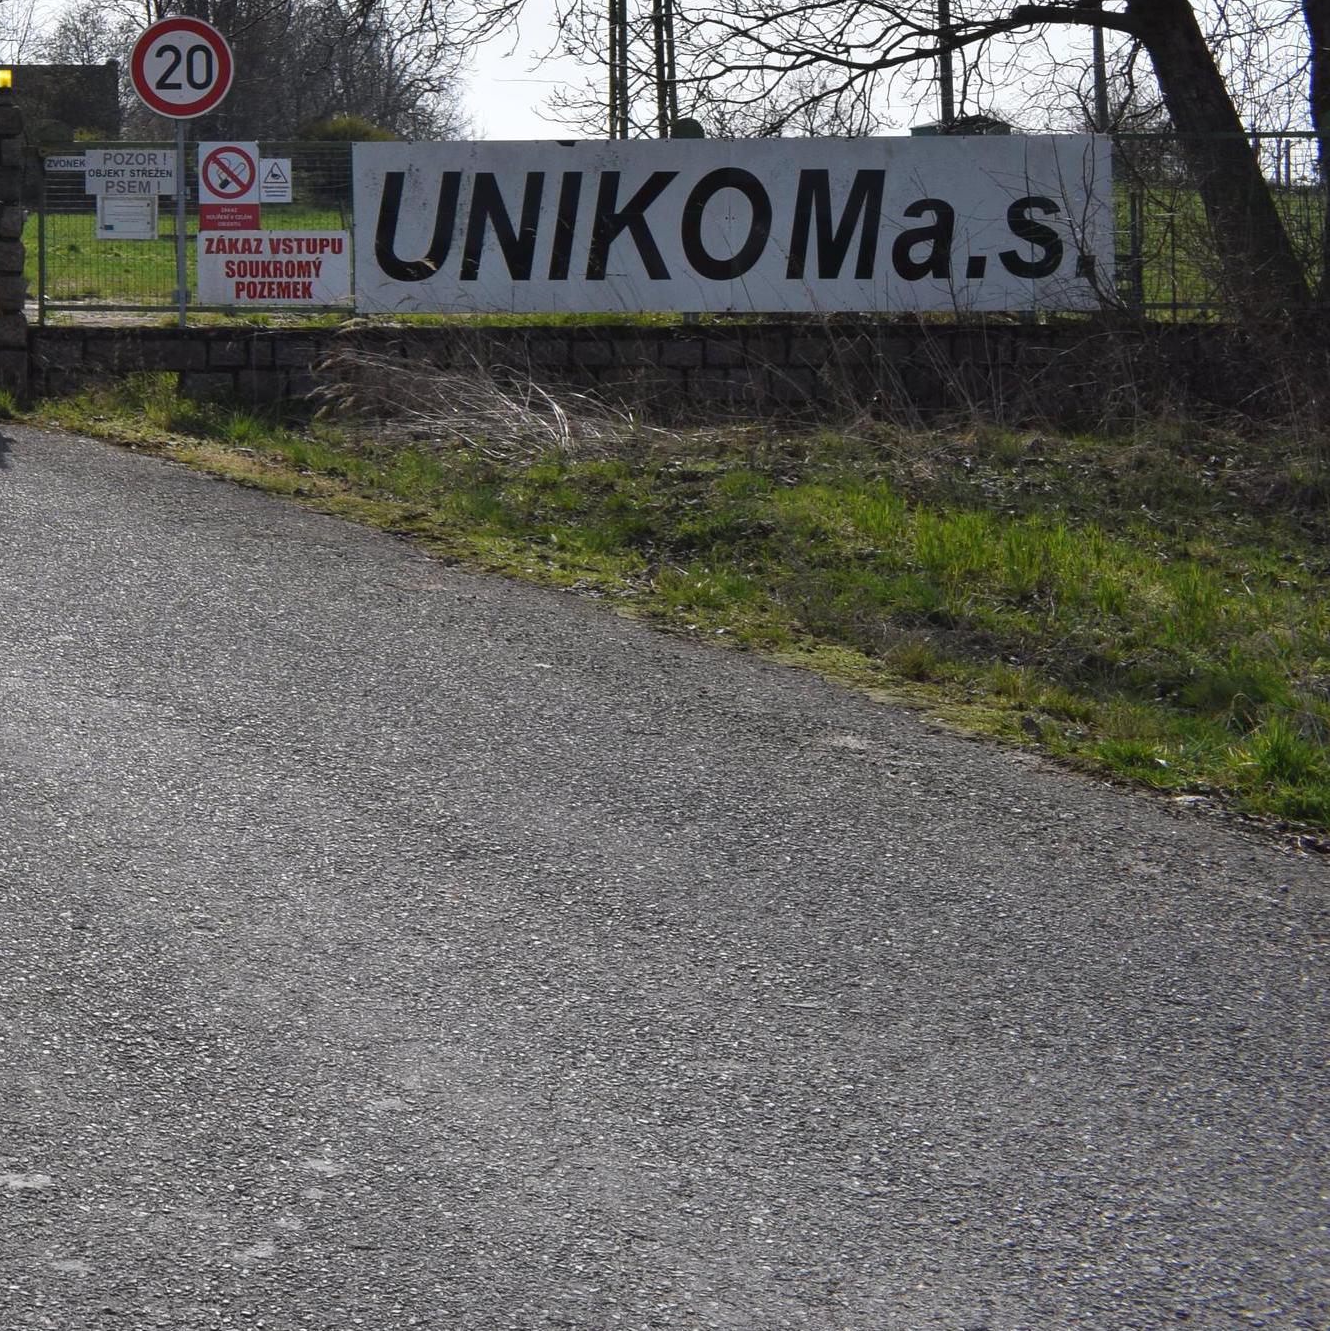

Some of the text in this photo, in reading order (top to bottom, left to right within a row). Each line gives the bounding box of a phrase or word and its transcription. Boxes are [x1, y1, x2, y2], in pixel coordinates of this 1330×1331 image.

[155, 44, 213, 90] 20
[47, 159, 86, 168] ZVONEK
[103, 153, 157, 165] POZOR
[88, 169, 124, 178] OBJEKT
[105, 180, 151, 193] PSEM
[205, 235, 343, 255] ZÁKAZ VSTUPU
[225, 257, 322, 279] SOUKROMÝ
[235, 281, 313, 299] POZEMEK
